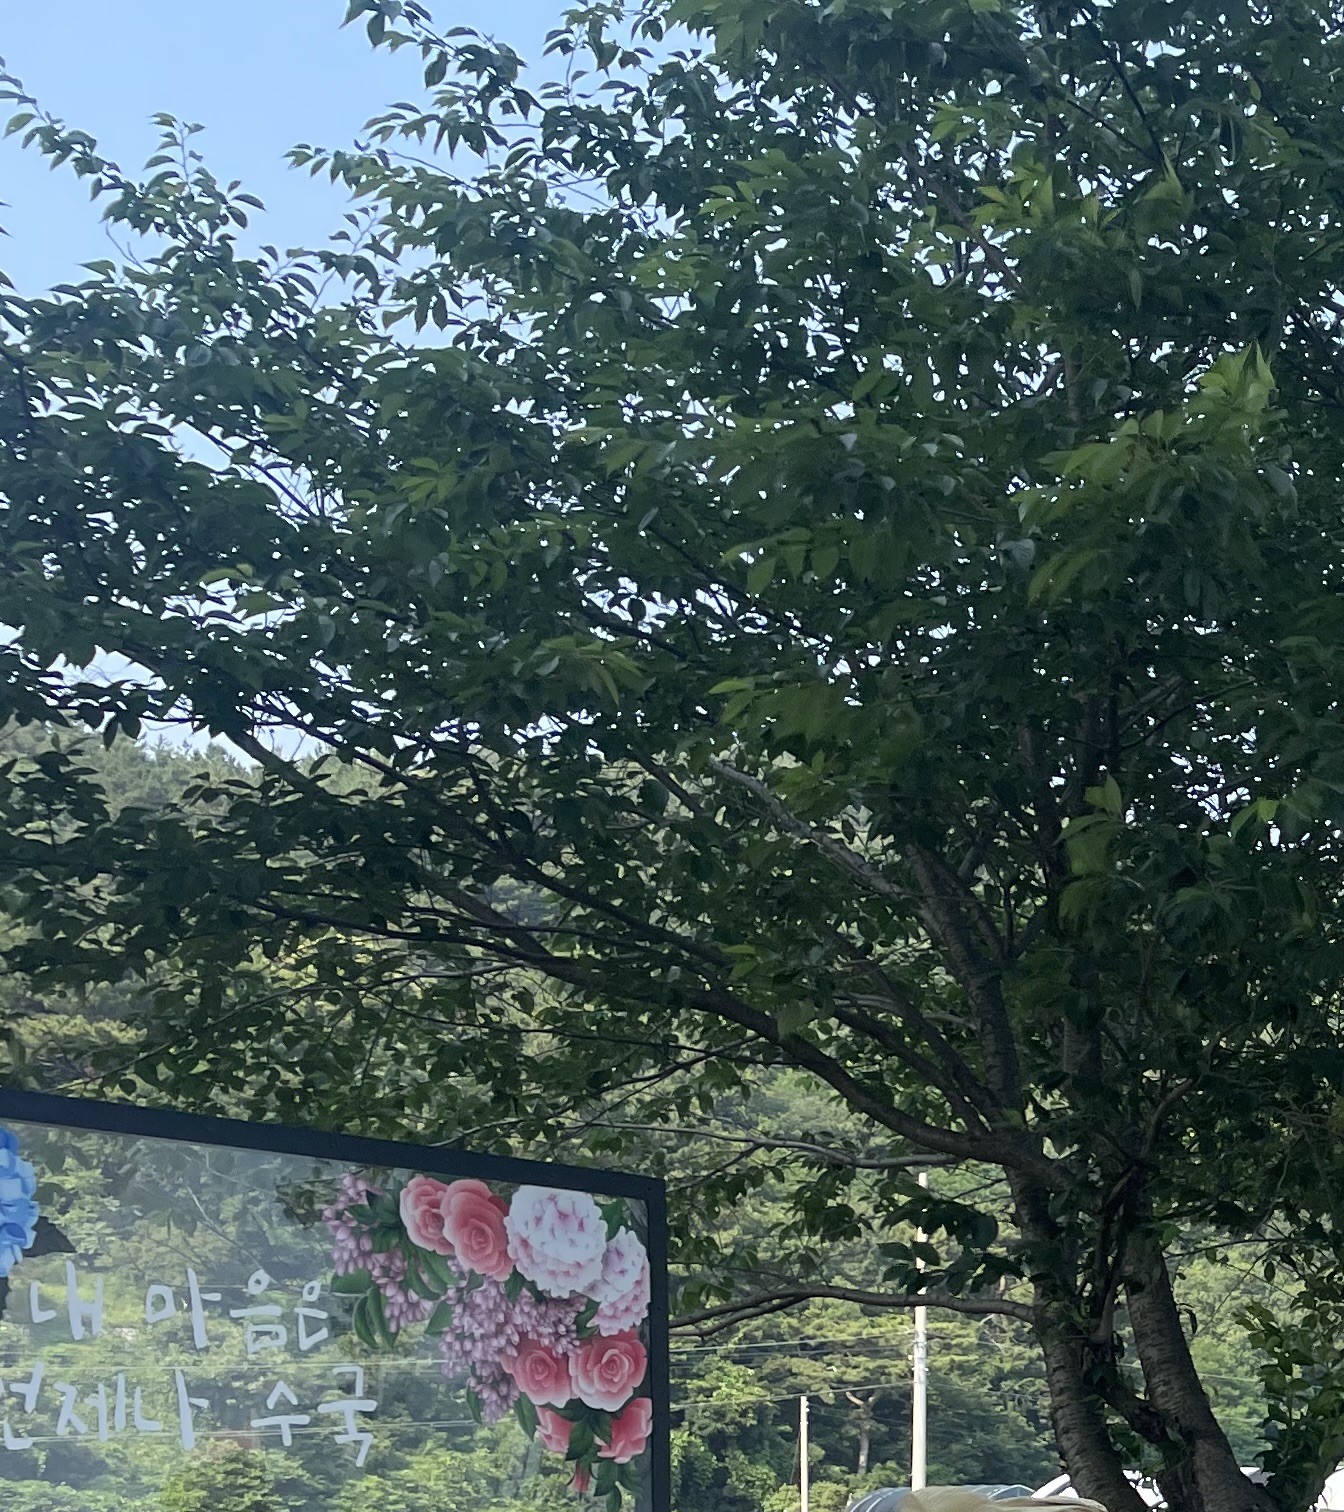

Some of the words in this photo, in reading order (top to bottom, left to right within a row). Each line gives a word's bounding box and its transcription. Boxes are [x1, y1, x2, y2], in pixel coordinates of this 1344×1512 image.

[29, 1260, 105, 1341] 내
[145, 1267, 329, 1358] 마음은
[250, 1365, 378, 1468] 수국
